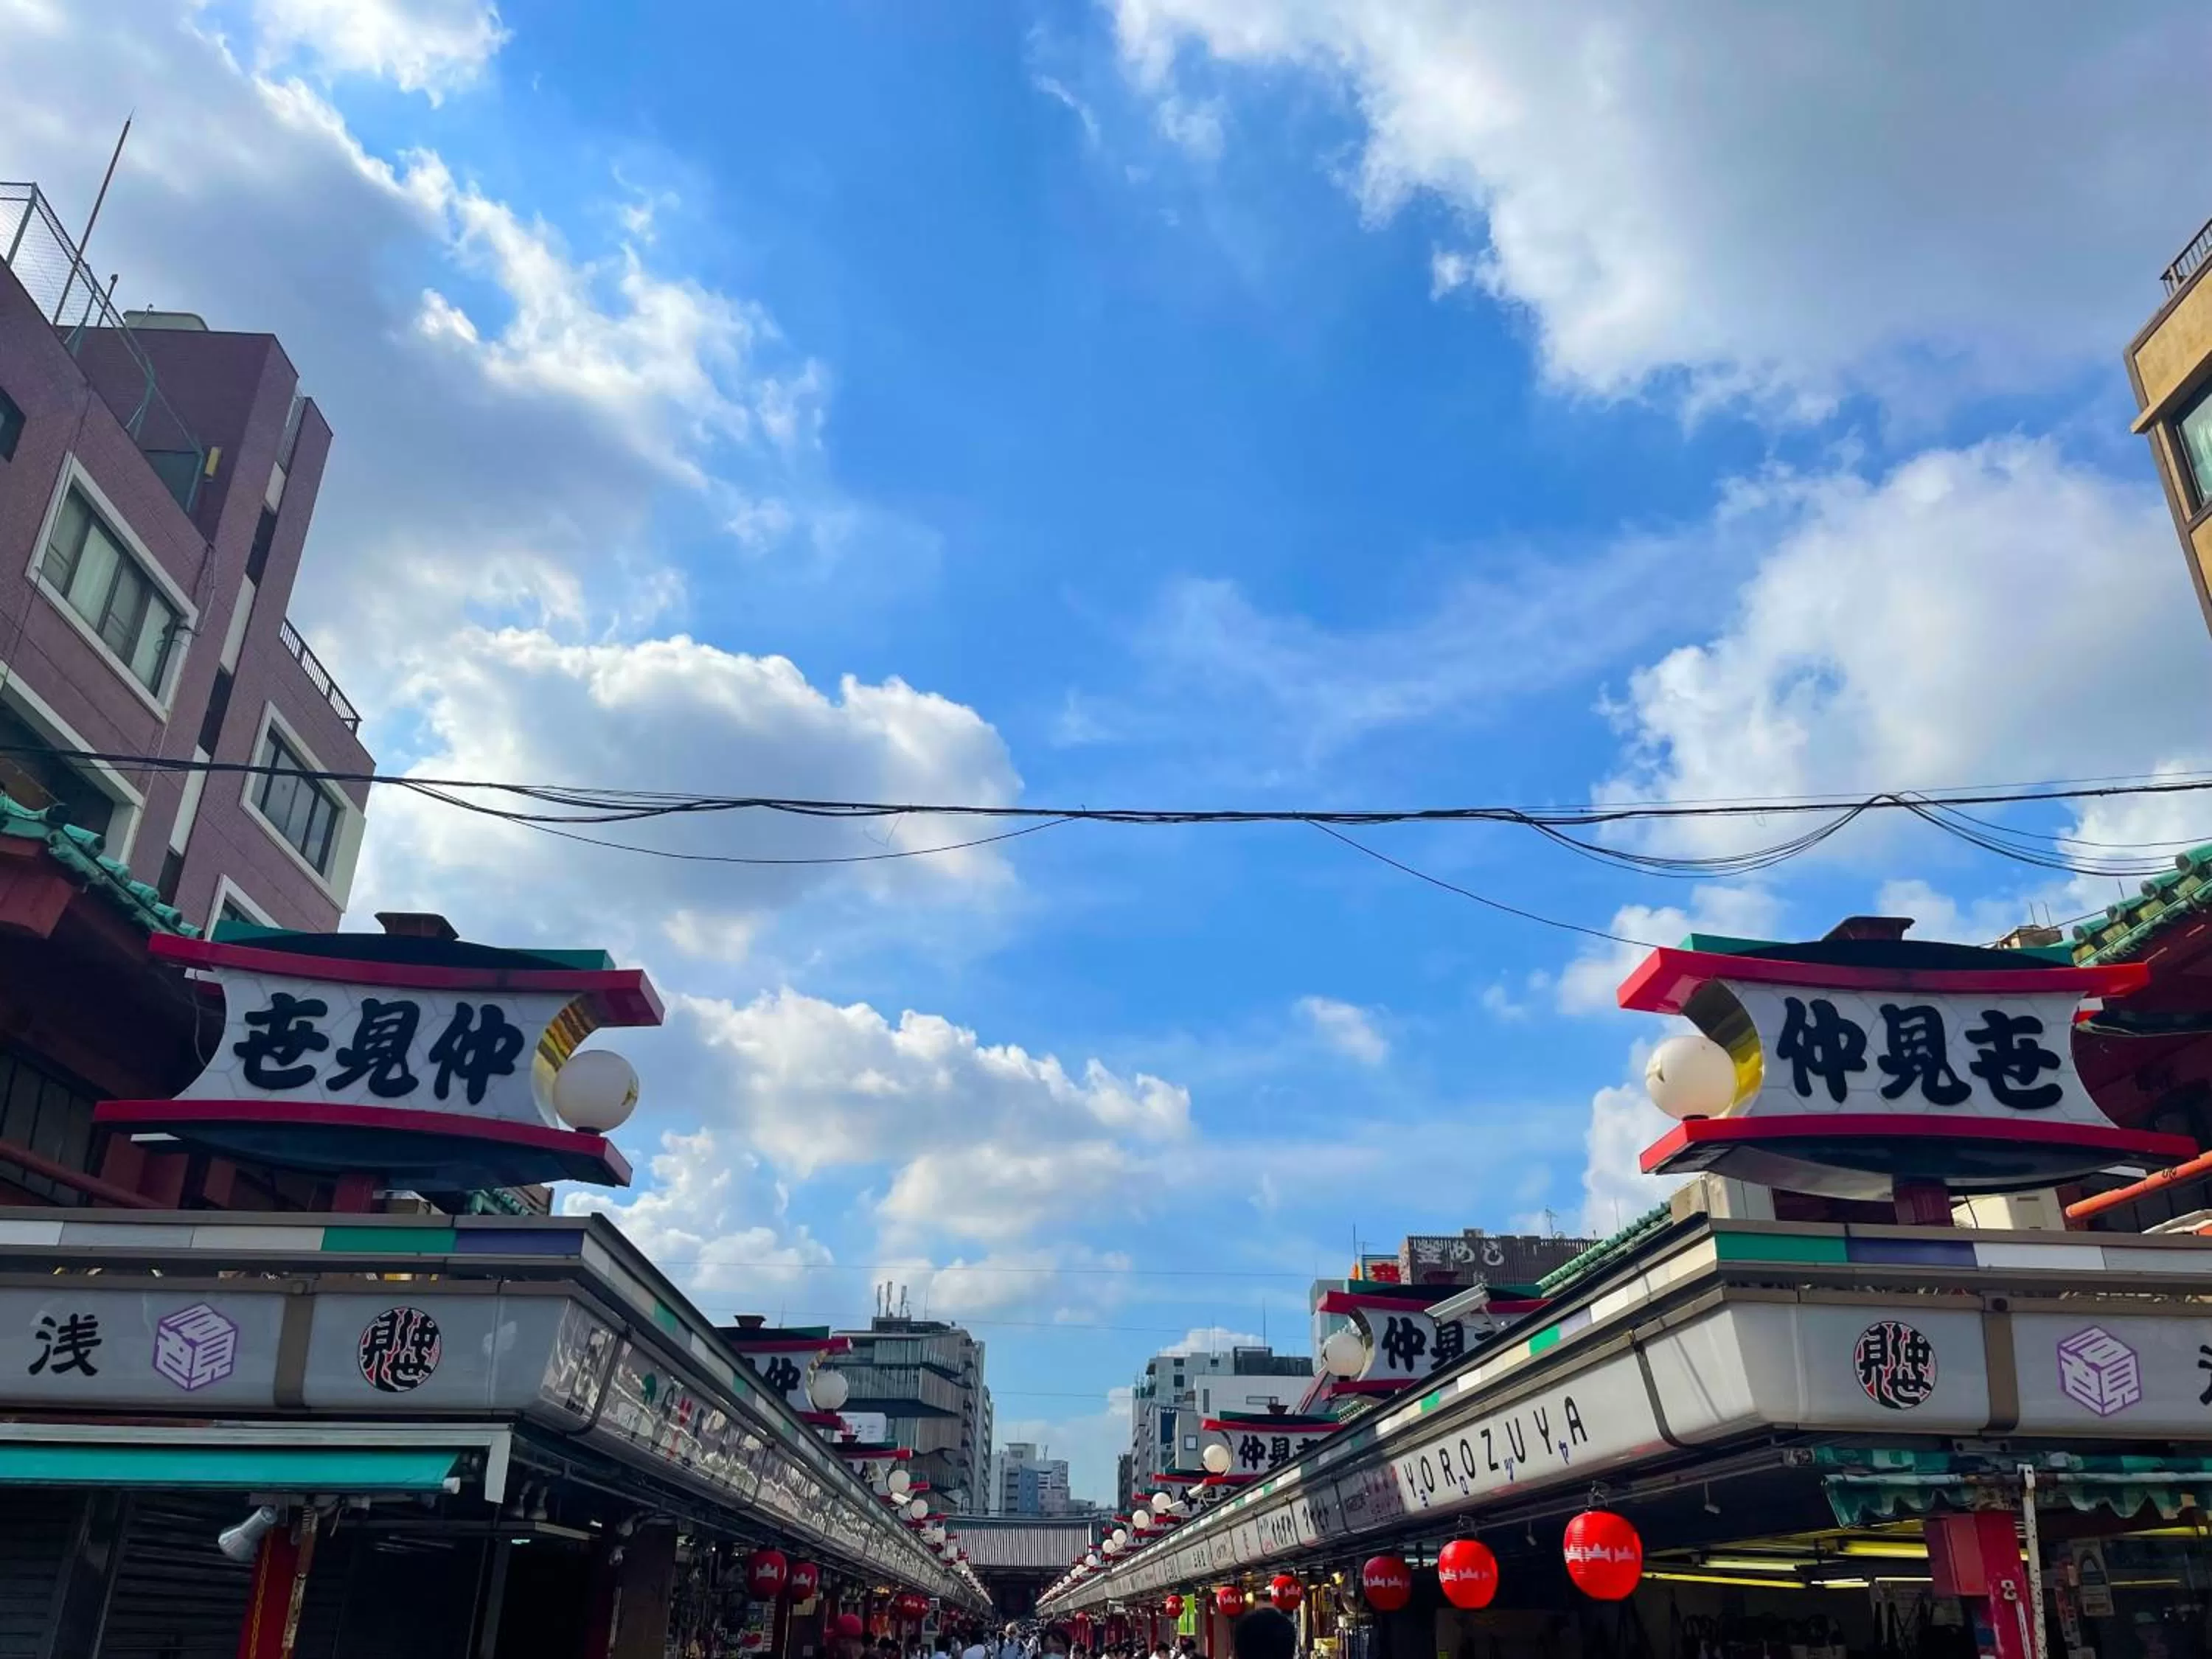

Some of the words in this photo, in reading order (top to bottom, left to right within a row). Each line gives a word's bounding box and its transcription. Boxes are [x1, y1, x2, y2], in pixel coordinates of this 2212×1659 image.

[1777, 996, 2065, 1110] 仲見世
[28, 1312, 102, 1376] 浅
[1382, 1316, 1499, 1372] 仲見
[1404, 1397, 1587, 1498] YOROZUYA
